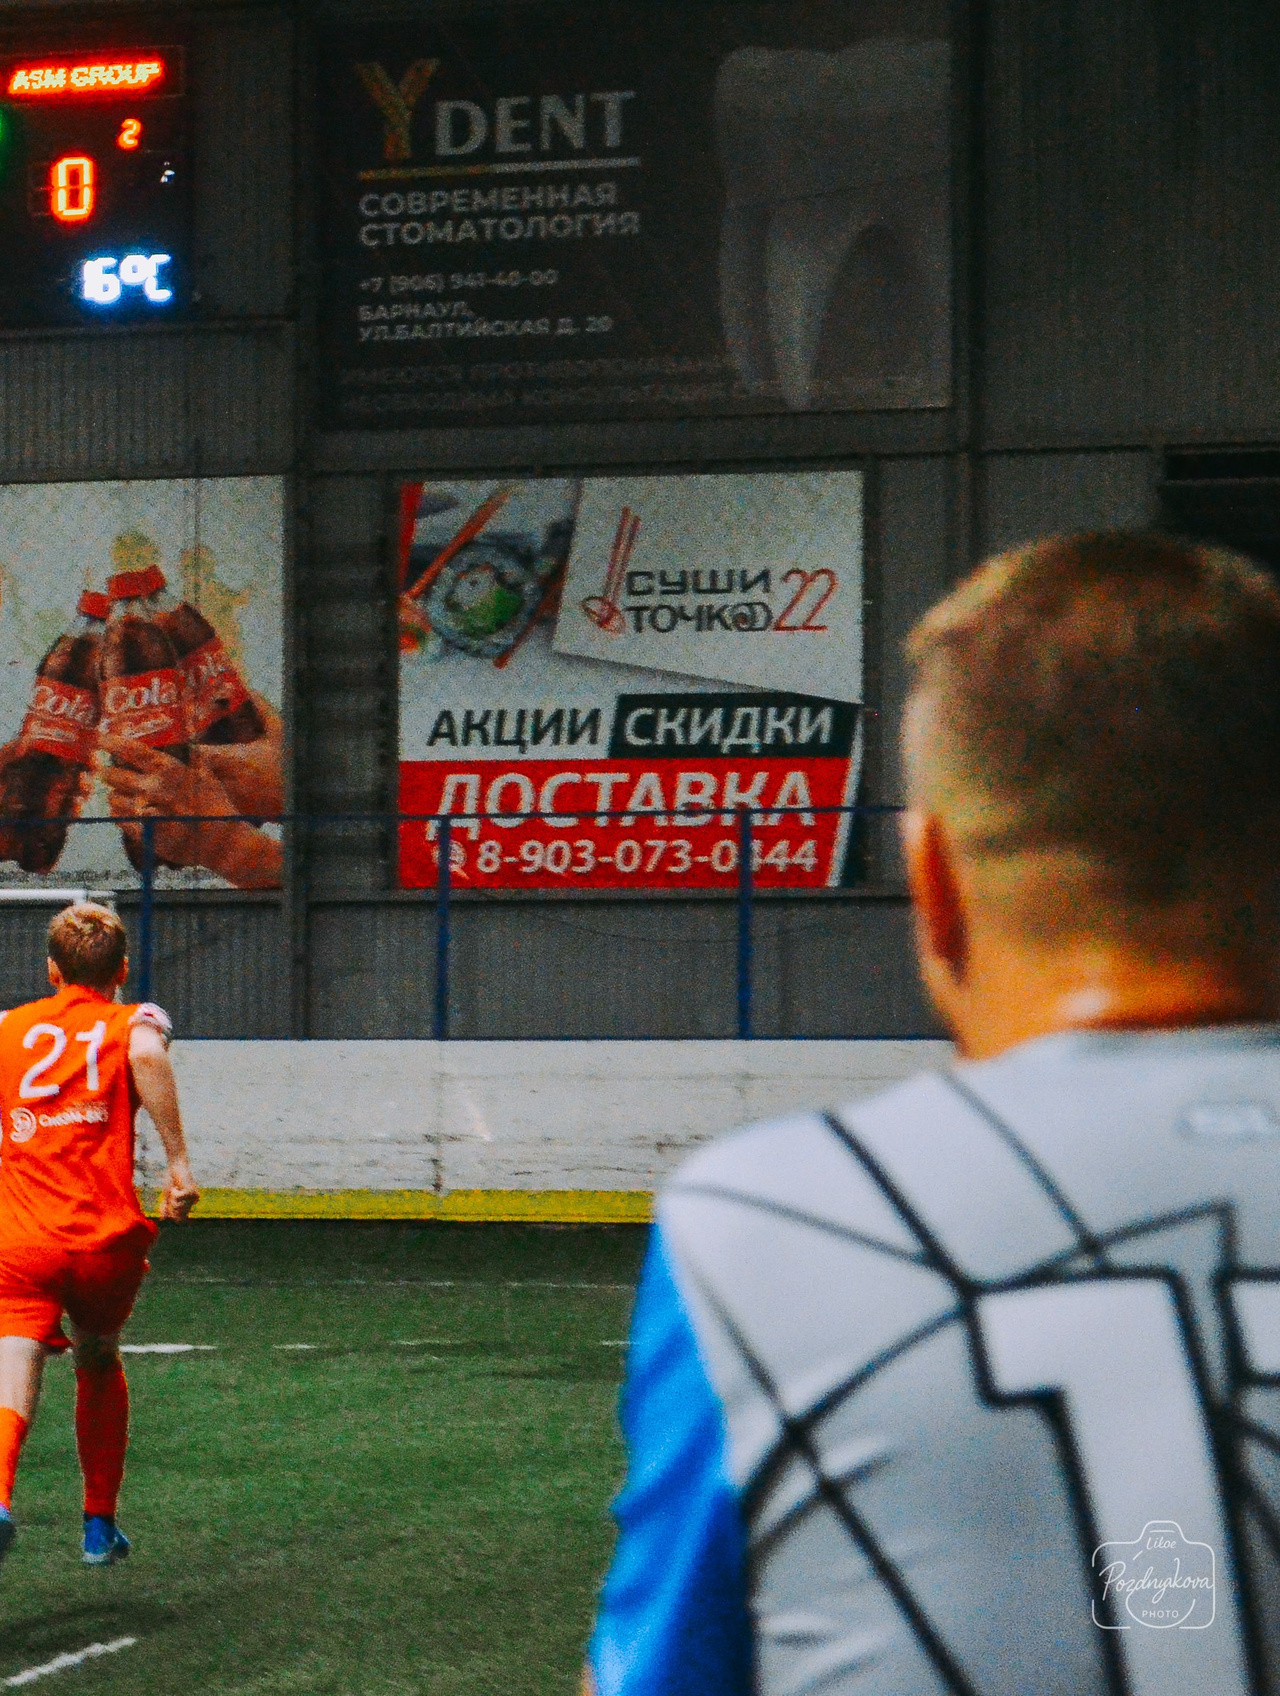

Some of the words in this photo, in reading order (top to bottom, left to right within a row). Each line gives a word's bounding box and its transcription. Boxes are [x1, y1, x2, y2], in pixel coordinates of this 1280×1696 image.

[12, 69, 66, 90] ASM
[70, 62, 161, 87] GROUP
[119, 118, 142, 149] 2
[52, 155, 94, 222] 0
[358, 181, 618, 217] СОВРЕМЕННАЯ
[358, 211, 640, 249] СТОМАТОЛОГИЯ
[626, 568, 771, 596] СУШИ
[772, 567, 840, 633] 22
[426, 707, 602, 753] АКЦИИ
[624, 704, 834, 754] СКИДКИ
[425, 771, 818, 841] ДОСТАВКА
[18, 1019, 108, 1100] 21
